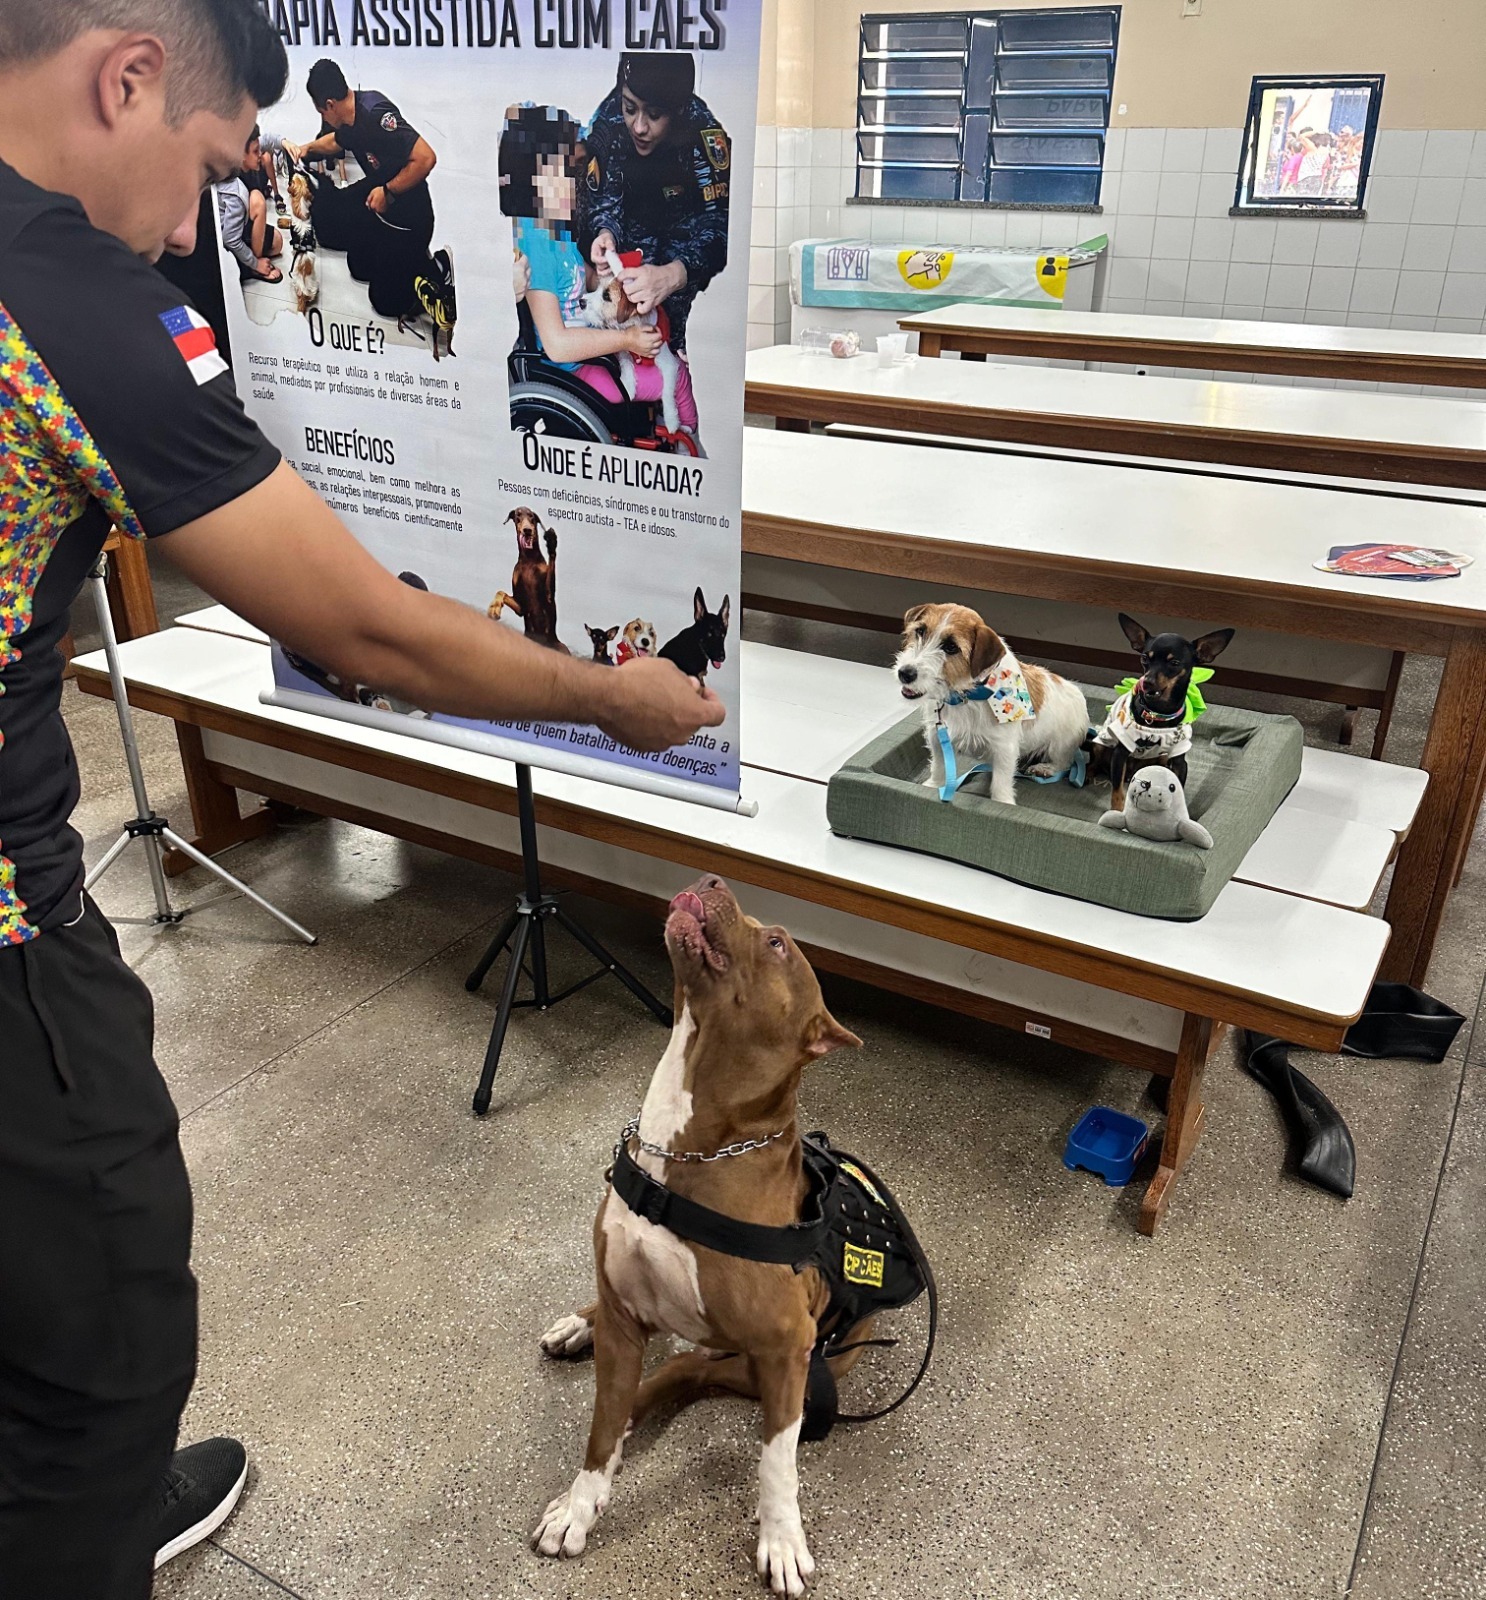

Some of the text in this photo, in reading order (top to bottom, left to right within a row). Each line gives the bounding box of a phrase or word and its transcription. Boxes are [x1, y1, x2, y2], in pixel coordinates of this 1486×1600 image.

[264, 0, 341, 46] APIA
[352, 0, 520, 48] ASSISTIDA
[534, 0, 609, 49] COM
[308, 307, 385, 354] O QUE É?
[248, 352, 460, 391] Recurso terapêutico que utiliza a relação homem e
[251, 370, 462, 410] animal, mediados por profissionais de diversas áreas da
[253, 387, 275, 401] saúde
[304, 427, 395, 466] BENEFÍCIOS
[522, 432, 703, 497] ONDE É APLICADA?
[301, 459, 324, 475] social,
[326, 466, 367, 483] emocional,
[369, 471, 386, 485] bem
[389, 477, 411, 489] como
[414, 479, 447, 496] melhora
[451, 486, 461, 498] as
[319, 482, 329, 492] as
[330, 482, 361, 500] relações
[362, 486, 414, 508] interpessoais,
[415, 497, 462, 515] promovendo
[362, 503, 400, 521] benefícios
[404, 511, 463, 532] cientificamente
[498, 478, 730, 529] Pessoas com deficiências, síndromes e ou transtorno do
[547, 507, 584, 523] espectro
[585, 510, 614, 527] autista
[624, 516, 639, 531] TEA
[641, 523, 647, 533] e
[648, 523, 678, 539] idosos.
[533, 724, 567, 741] quem
[569, 728, 617, 752] batalha
[687, 733, 731, 754] enta a
